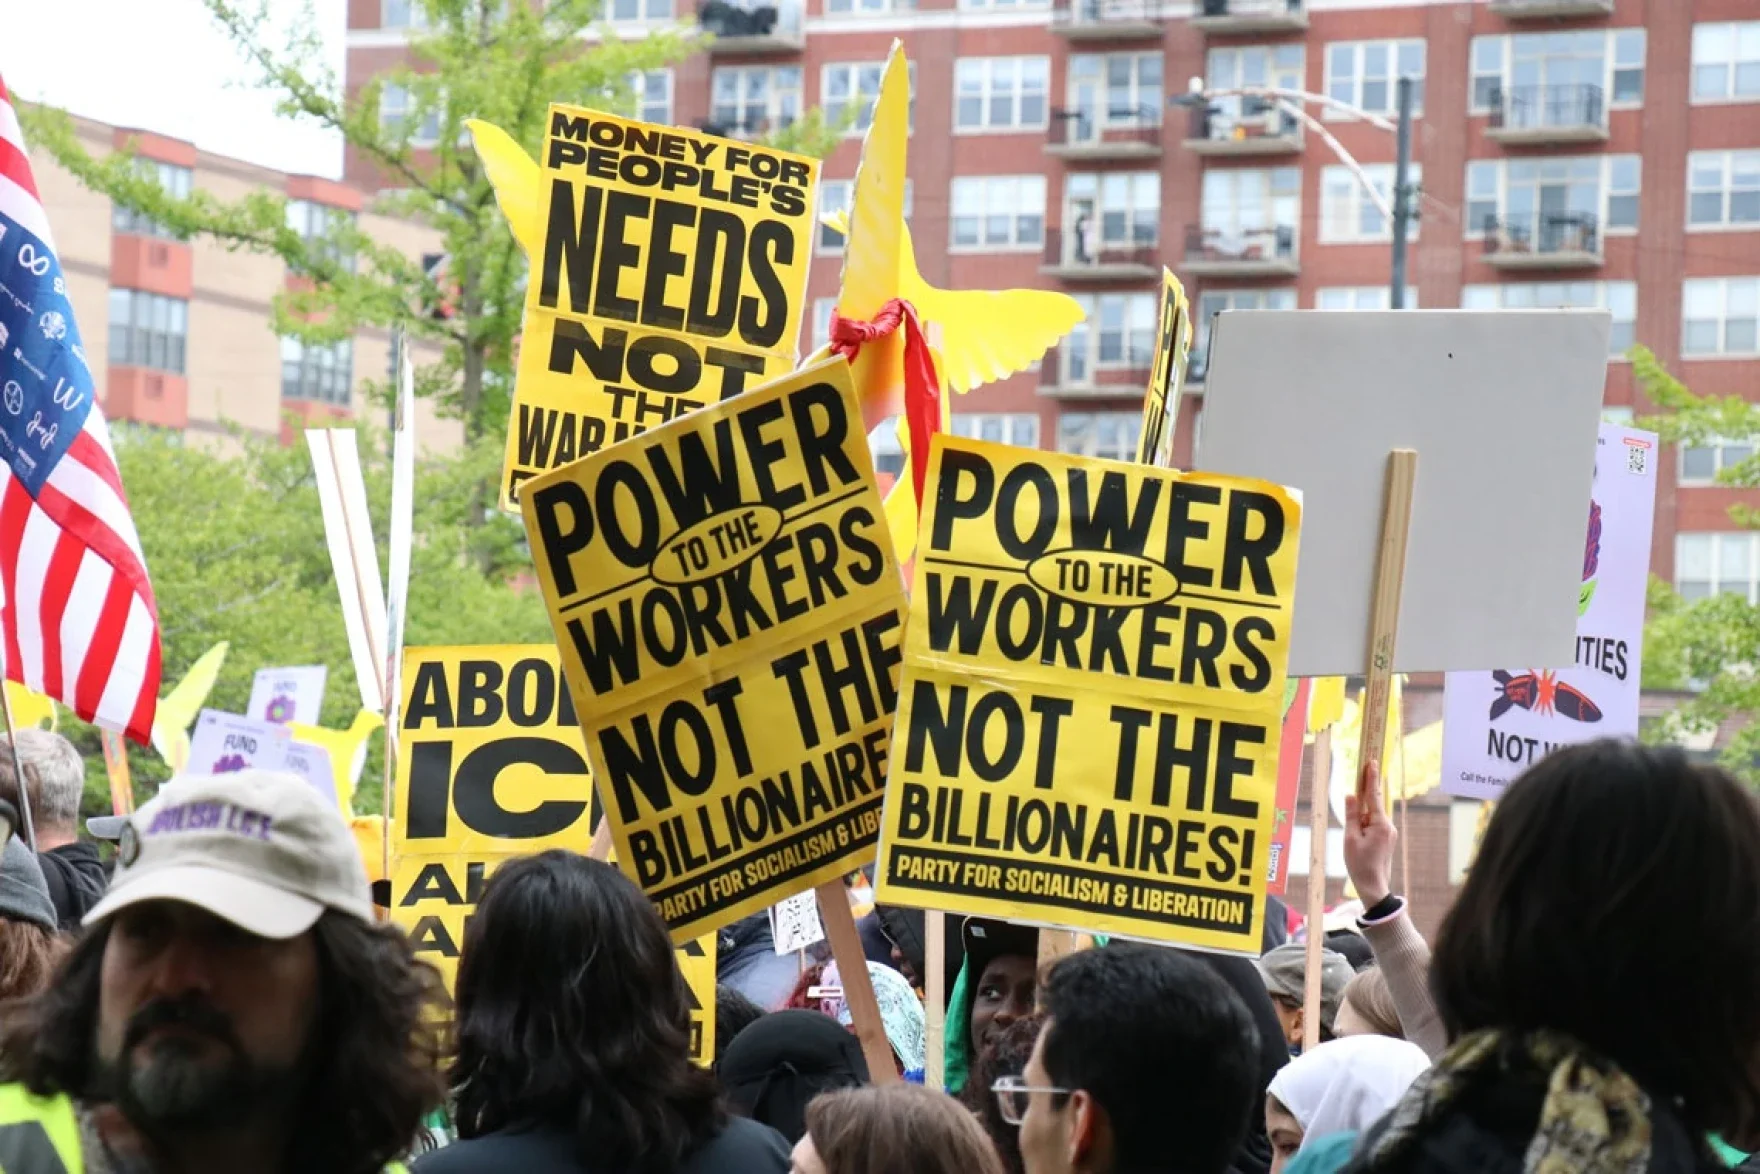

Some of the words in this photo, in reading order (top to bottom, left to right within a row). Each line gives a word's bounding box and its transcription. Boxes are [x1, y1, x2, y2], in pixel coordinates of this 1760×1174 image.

[548, 139, 806, 217] PEOPLE'S
[550, 112, 718, 166] MONEY
[725, 147, 810, 188] FOR
[539, 178, 794, 348] NEEDS
[548, 317, 766, 401] NOT
[533, 383, 861, 599] POWER
[930, 448, 1284, 597] POWER
[671, 536, 709, 577] TO
[711, 511, 764, 559] THE
[1055, 558, 1089, 593] TO
[1098, 561, 1153, 598] THE
[566, 506, 884, 697] WORKERS
[925, 572, 1276, 693] WORKERS
[1575, 635, 1628, 681] ITIES
[224, 733, 258, 755] FUND
[598, 676, 754, 825] NOT
[771, 609, 904, 750] THE
[904, 679, 1074, 790] NOT
[1109, 705, 1267, 820] THE
[1487, 728, 1538, 765] NOT
[406, 736, 606, 840] IC
[628, 728, 894, 890] BILLIONAIRE
[897, 782, 1256, 887] BILLIONAIRES!
[709, 869, 745, 902] FOR
[744, 828, 837, 883] SOCIALISM
[836, 823, 849, 846] &
[896, 854, 960, 886] PARTY
[962, 862, 1001, 890] FOR
[1004, 866, 1110, 905] SOCIALISM
[1113, 886, 1129, 907] &
[1131, 888, 1245, 925] LIBERATION
